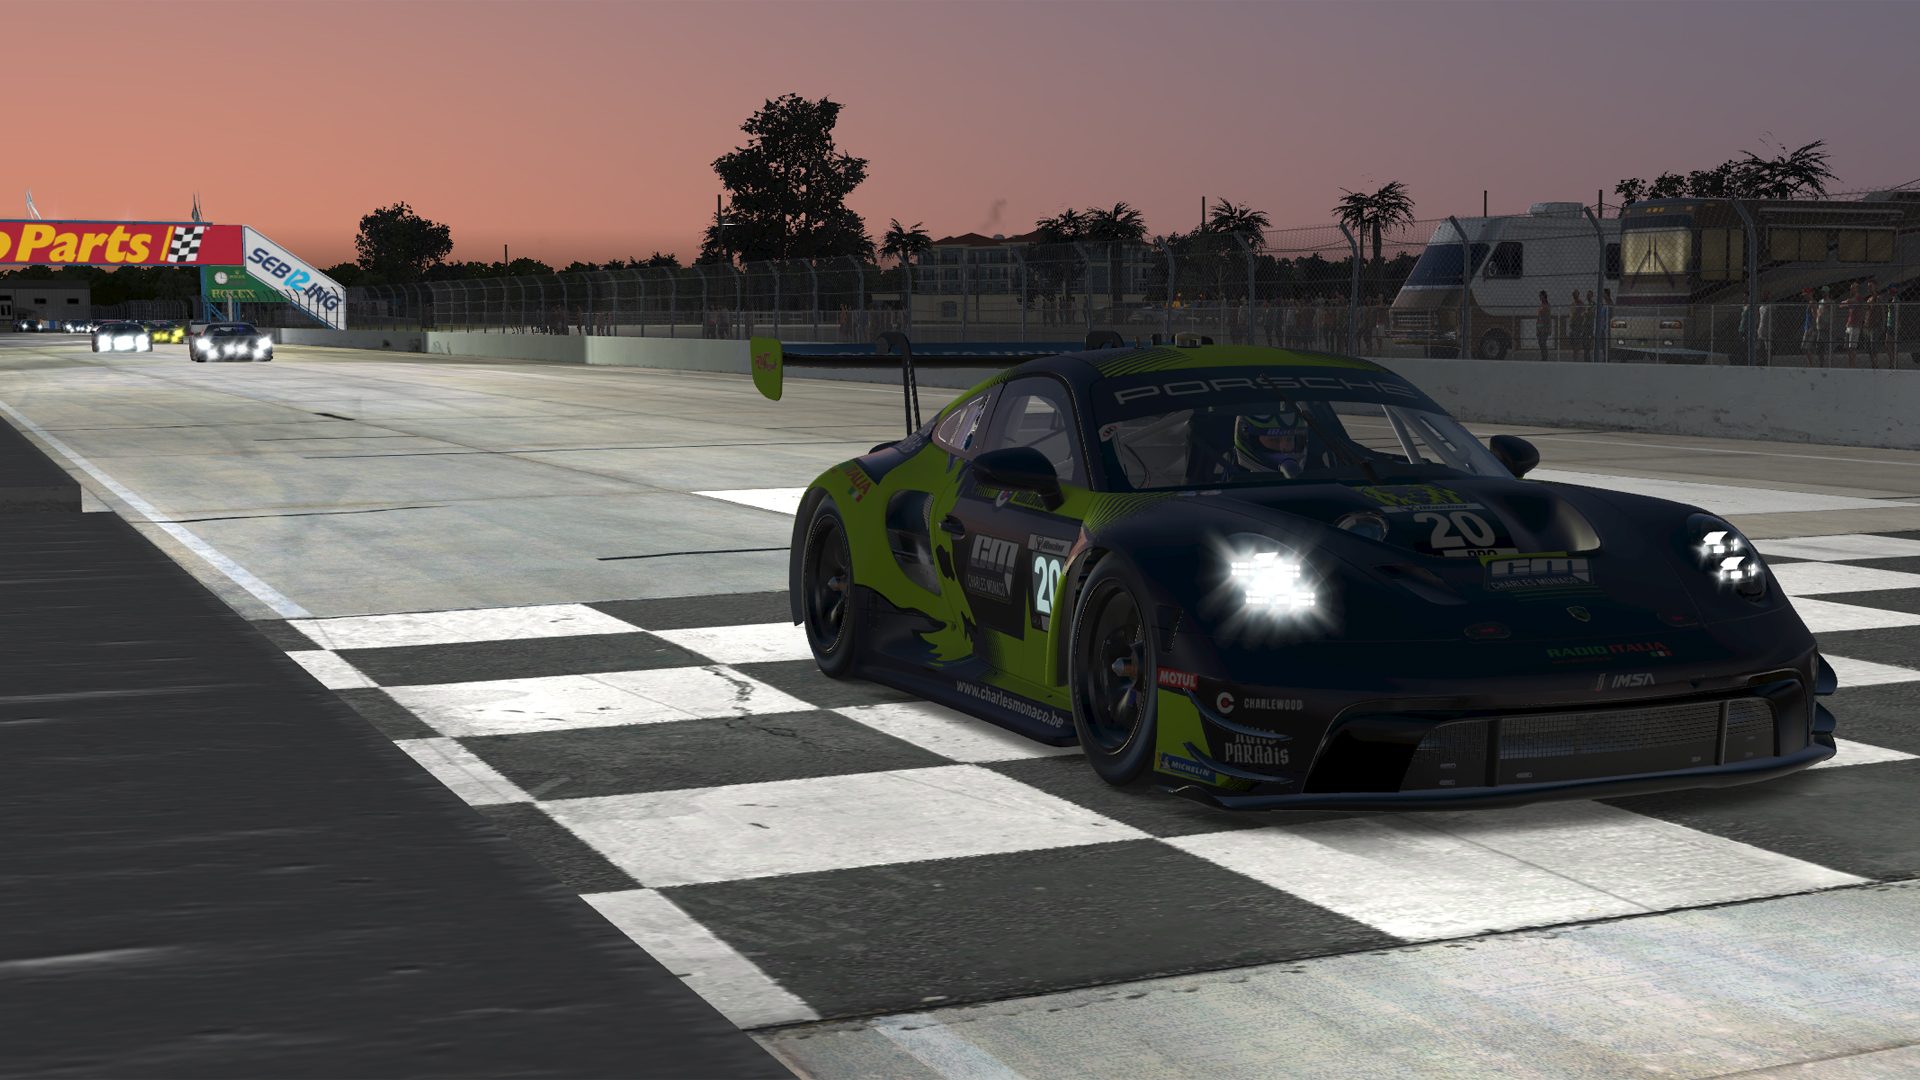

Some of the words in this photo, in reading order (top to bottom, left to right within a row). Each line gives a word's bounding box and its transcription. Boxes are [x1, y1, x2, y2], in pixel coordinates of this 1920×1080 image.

[15, 224, 151, 264] Parts
[1113, 377, 1419, 405] PORSCHE
[1413, 511, 1496, 549] 20
[1034, 556, 1062, 614] 20
[1546, 646, 1608, 657] RADIO
[1608, 641, 1669, 655] ITALIA
[1159, 670, 1196, 688] MOTUL
[1612, 673, 1656, 688] IMSA
[956, 680, 1064, 728] www.charlesmonaco.be
[1243, 698, 1304, 711] CHARLEWOOD
[1171, 760, 1210, 776] MICHELIN
